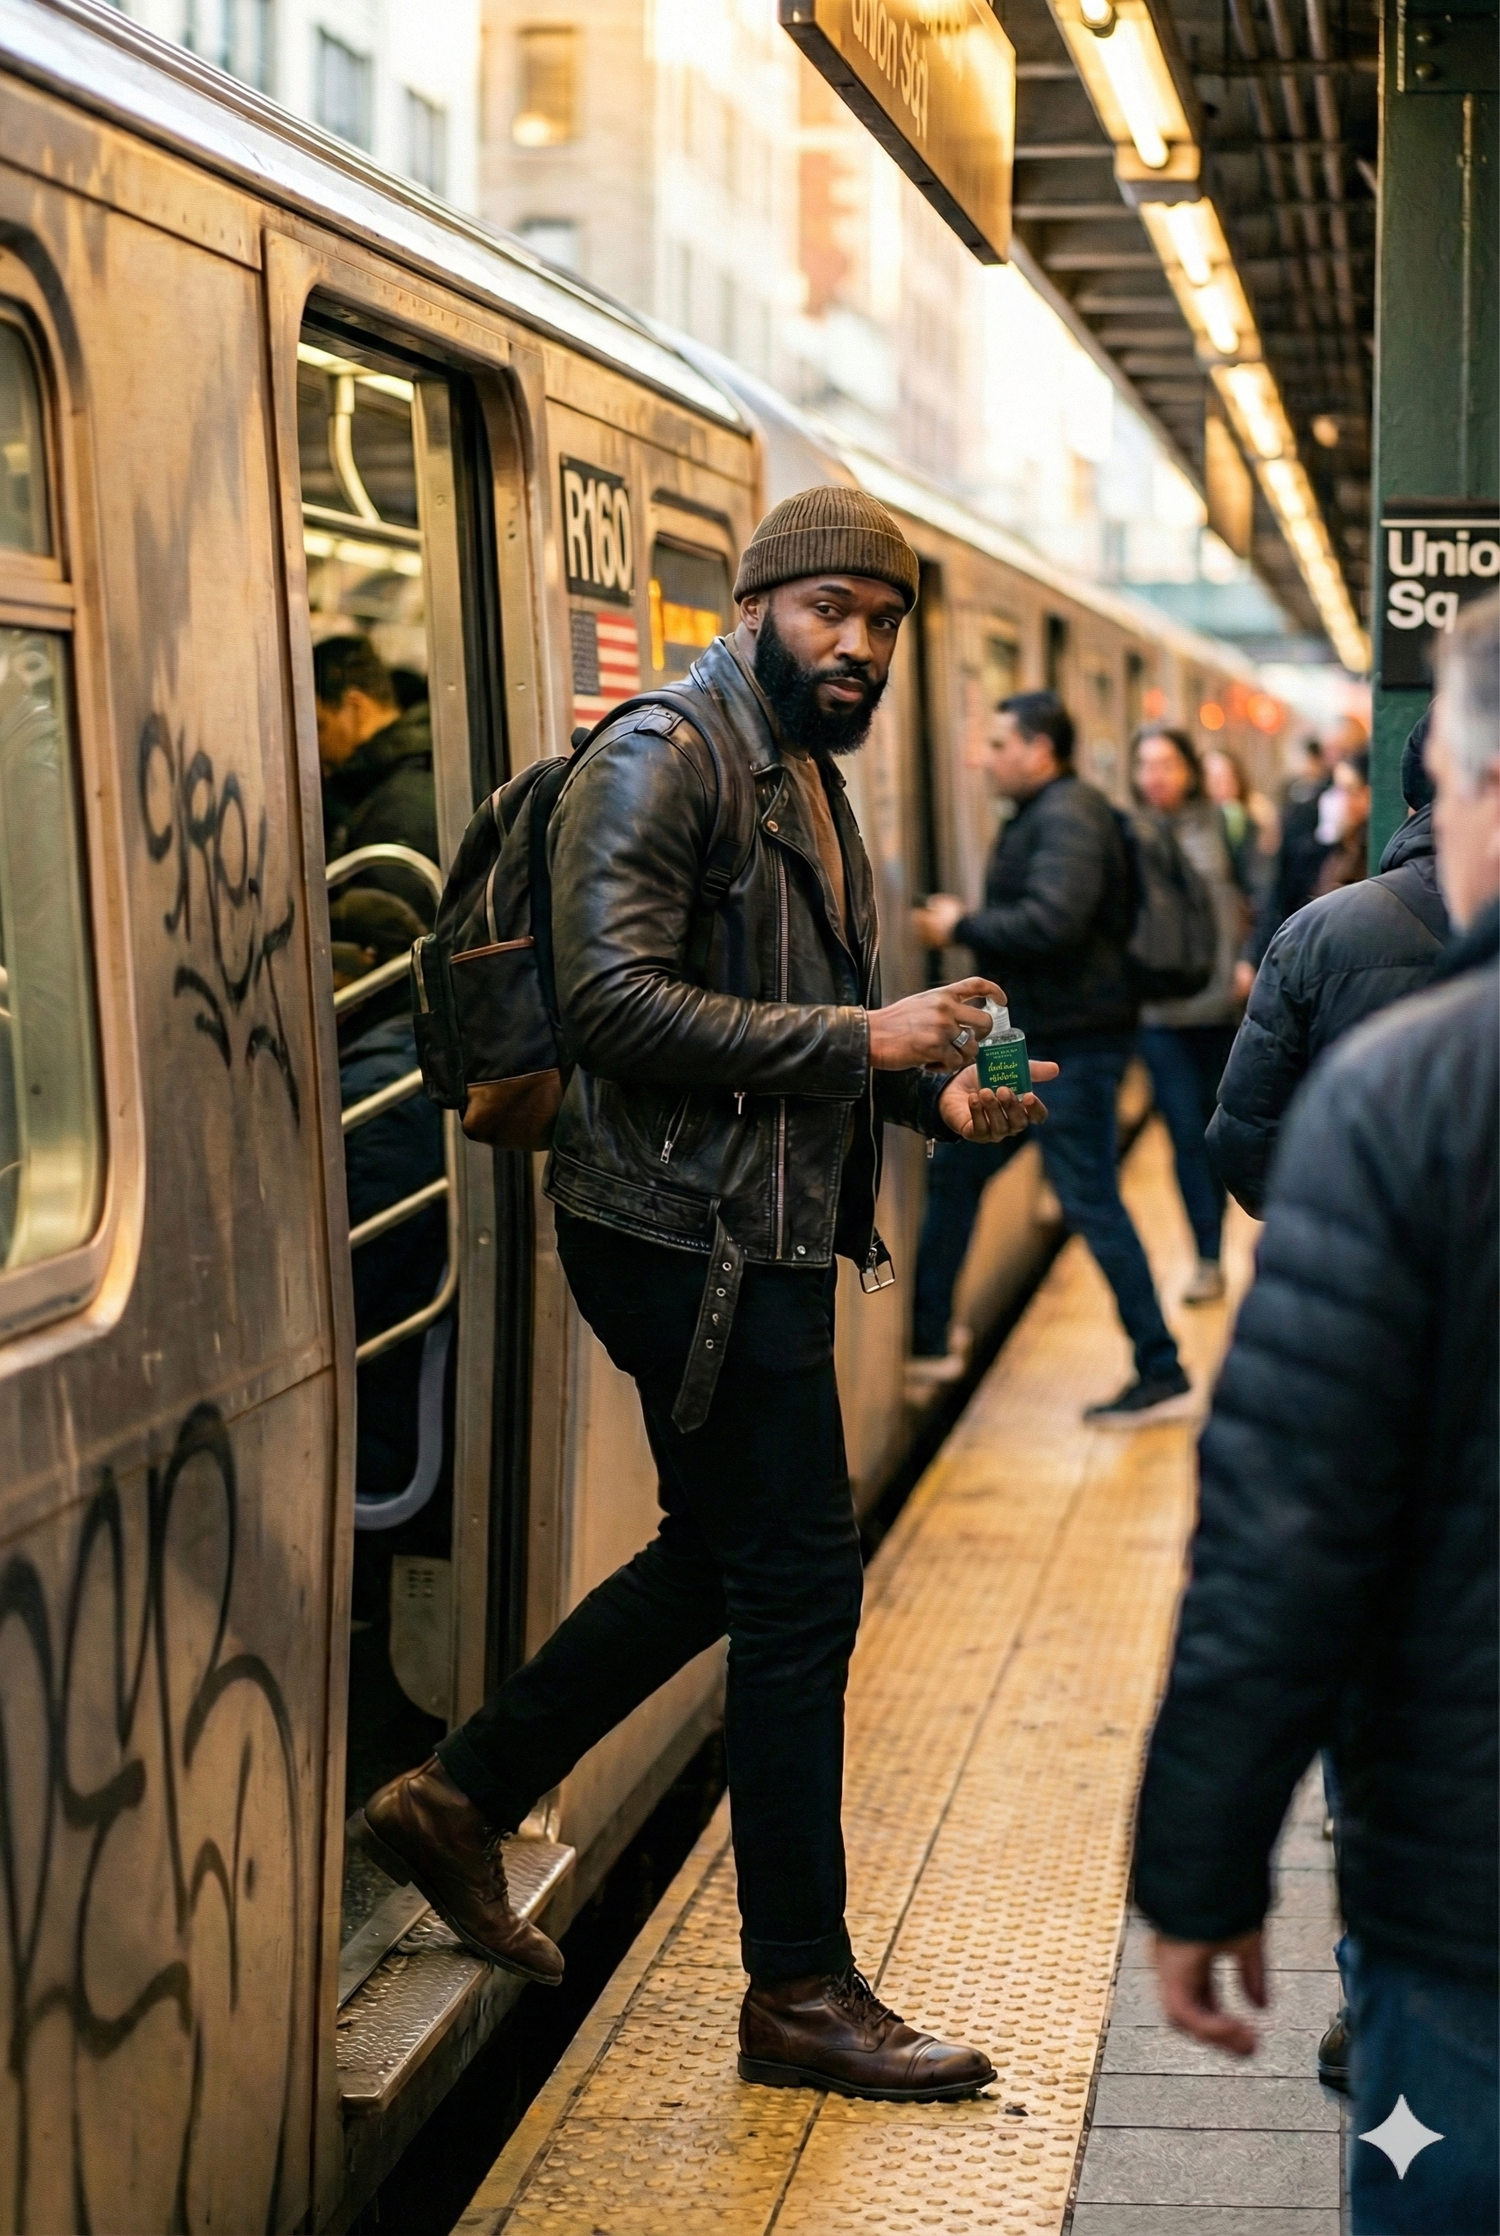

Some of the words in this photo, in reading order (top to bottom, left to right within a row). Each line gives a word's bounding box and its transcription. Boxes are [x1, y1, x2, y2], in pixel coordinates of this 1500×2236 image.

[564, 469, 633, 592] R160
[1388, 530, 1500, 578] Unio
[1387, 579, 1460, 634] Sq
